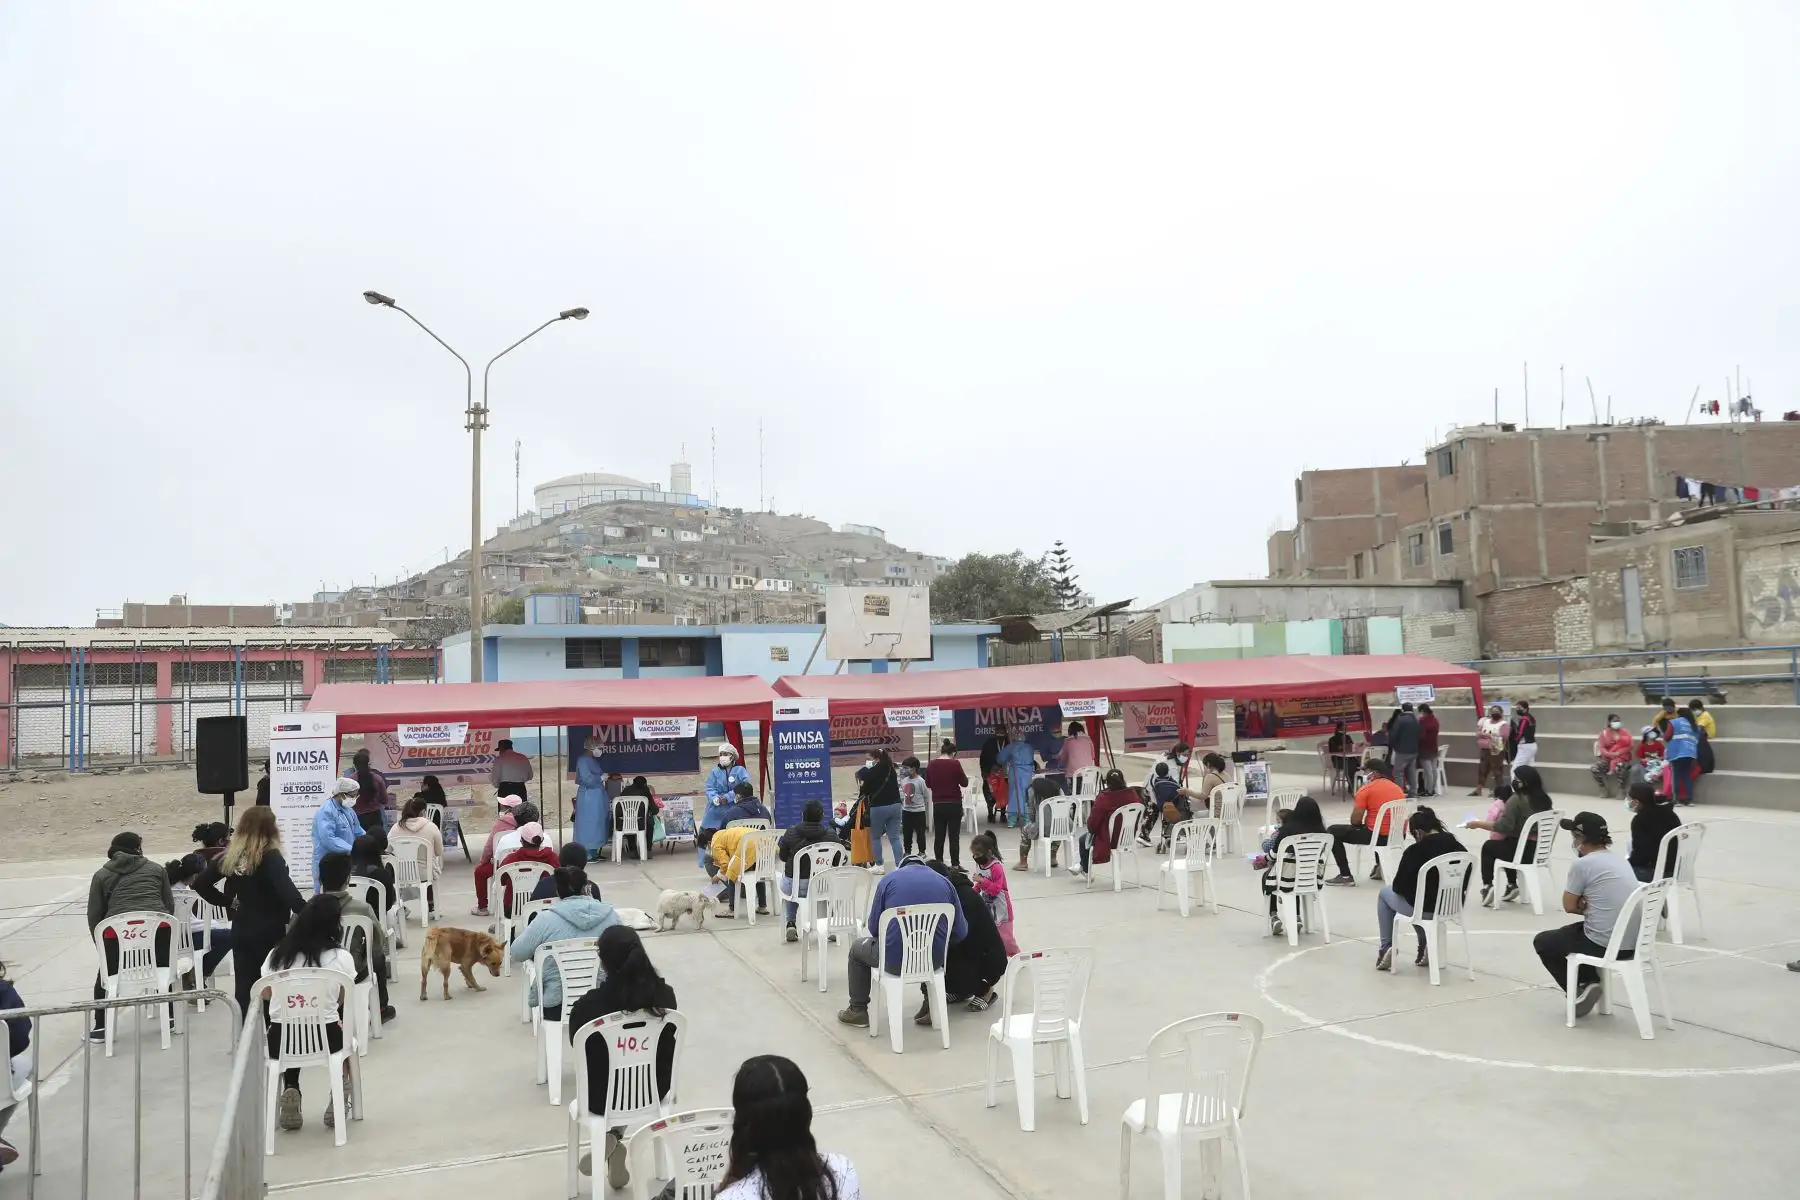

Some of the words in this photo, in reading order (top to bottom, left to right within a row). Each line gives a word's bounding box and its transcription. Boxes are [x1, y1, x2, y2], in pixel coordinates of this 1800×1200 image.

[888, 714, 925, 722] VACUNACIÓN
[975, 706, 1042, 725] MINSA
[829, 727, 895, 739] encuentro
[975, 726, 996, 735] DIRIS
[1018, 724, 1044, 733] NORTE
[404, 732, 450, 740] VACUNACIÓN
[475, 730, 492, 742] tu
[779, 731, 824, 744] MINSA
[407, 744, 490, 757] encuentro
[619, 743, 643, 753] LIMA
[645, 742, 676, 752] NORTE
[276, 750, 329, 765] MINSA
[795, 761, 821, 769] TODOS
[686, 1152, 724, 1164] CANTA
